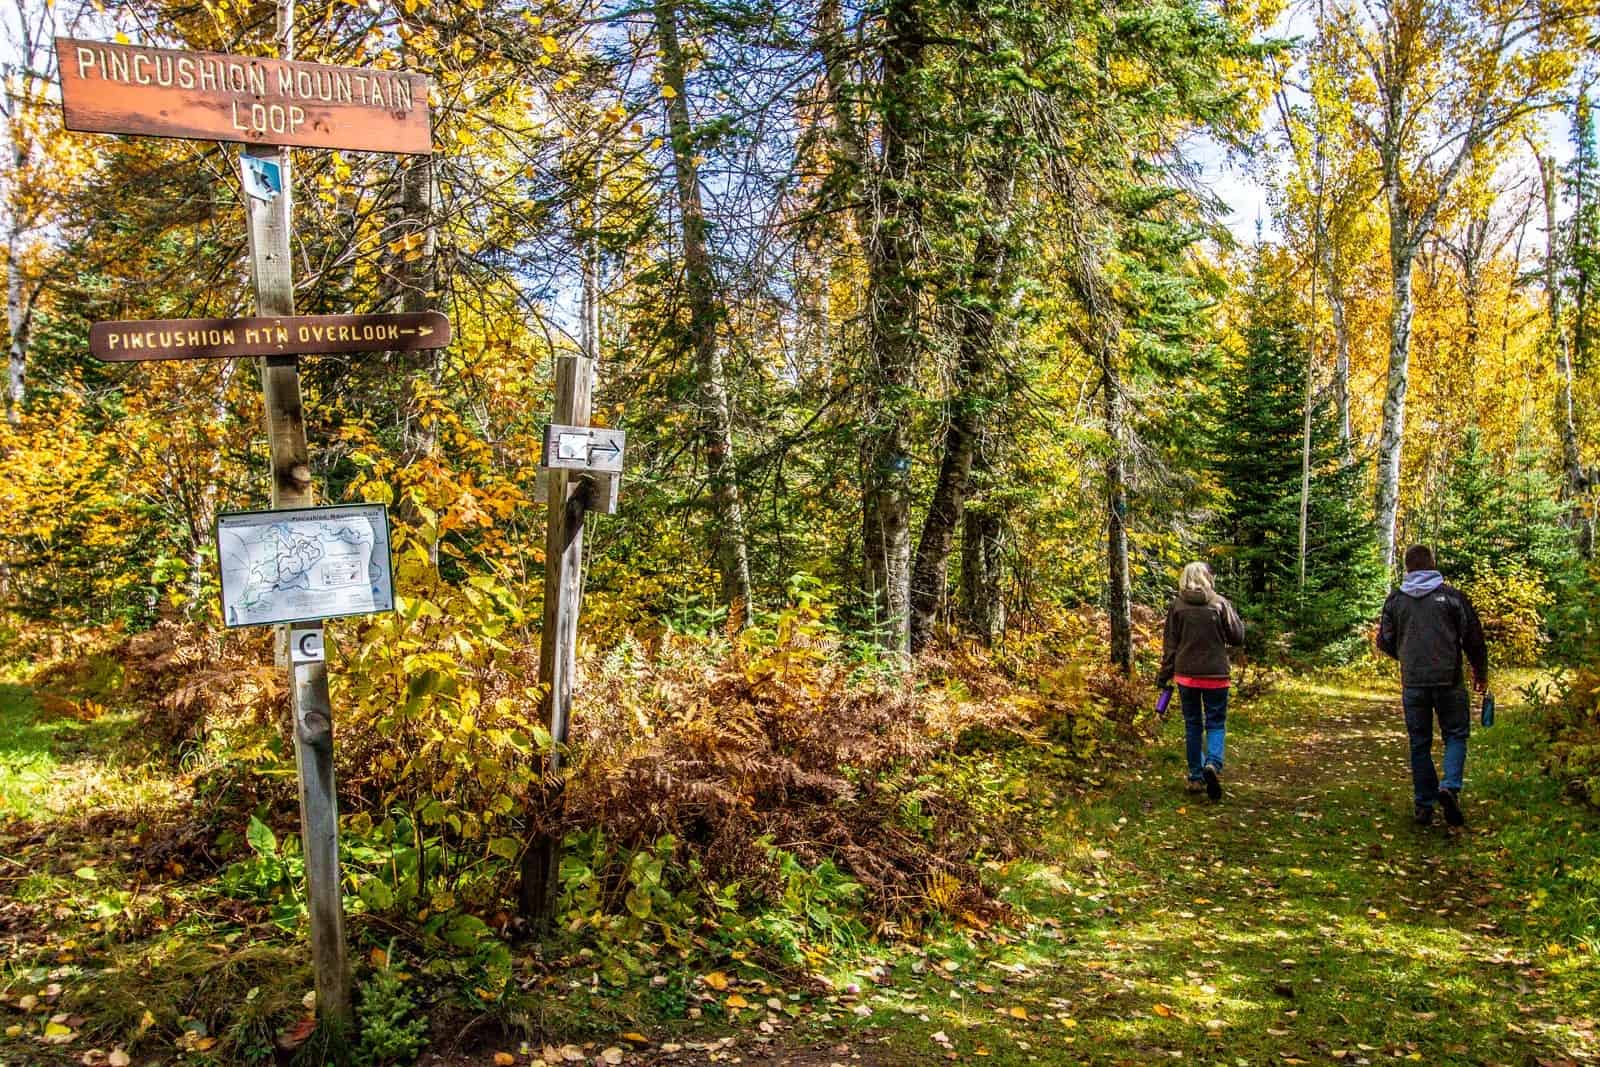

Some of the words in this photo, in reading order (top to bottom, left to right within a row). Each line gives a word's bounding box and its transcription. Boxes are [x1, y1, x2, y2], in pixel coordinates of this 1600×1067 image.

[77, 47, 265, 96] PINCUSHION
[278, 66, 411, 109] MOUNTAIN
[232, 101, 305, 134] LOOP
[108, 328, 235, 349] PINCUSHION
[246, 328, 288, 345] MTN
[299, 324, 398, 342] OVERLOOK
[300, 633, 318, 657] C
